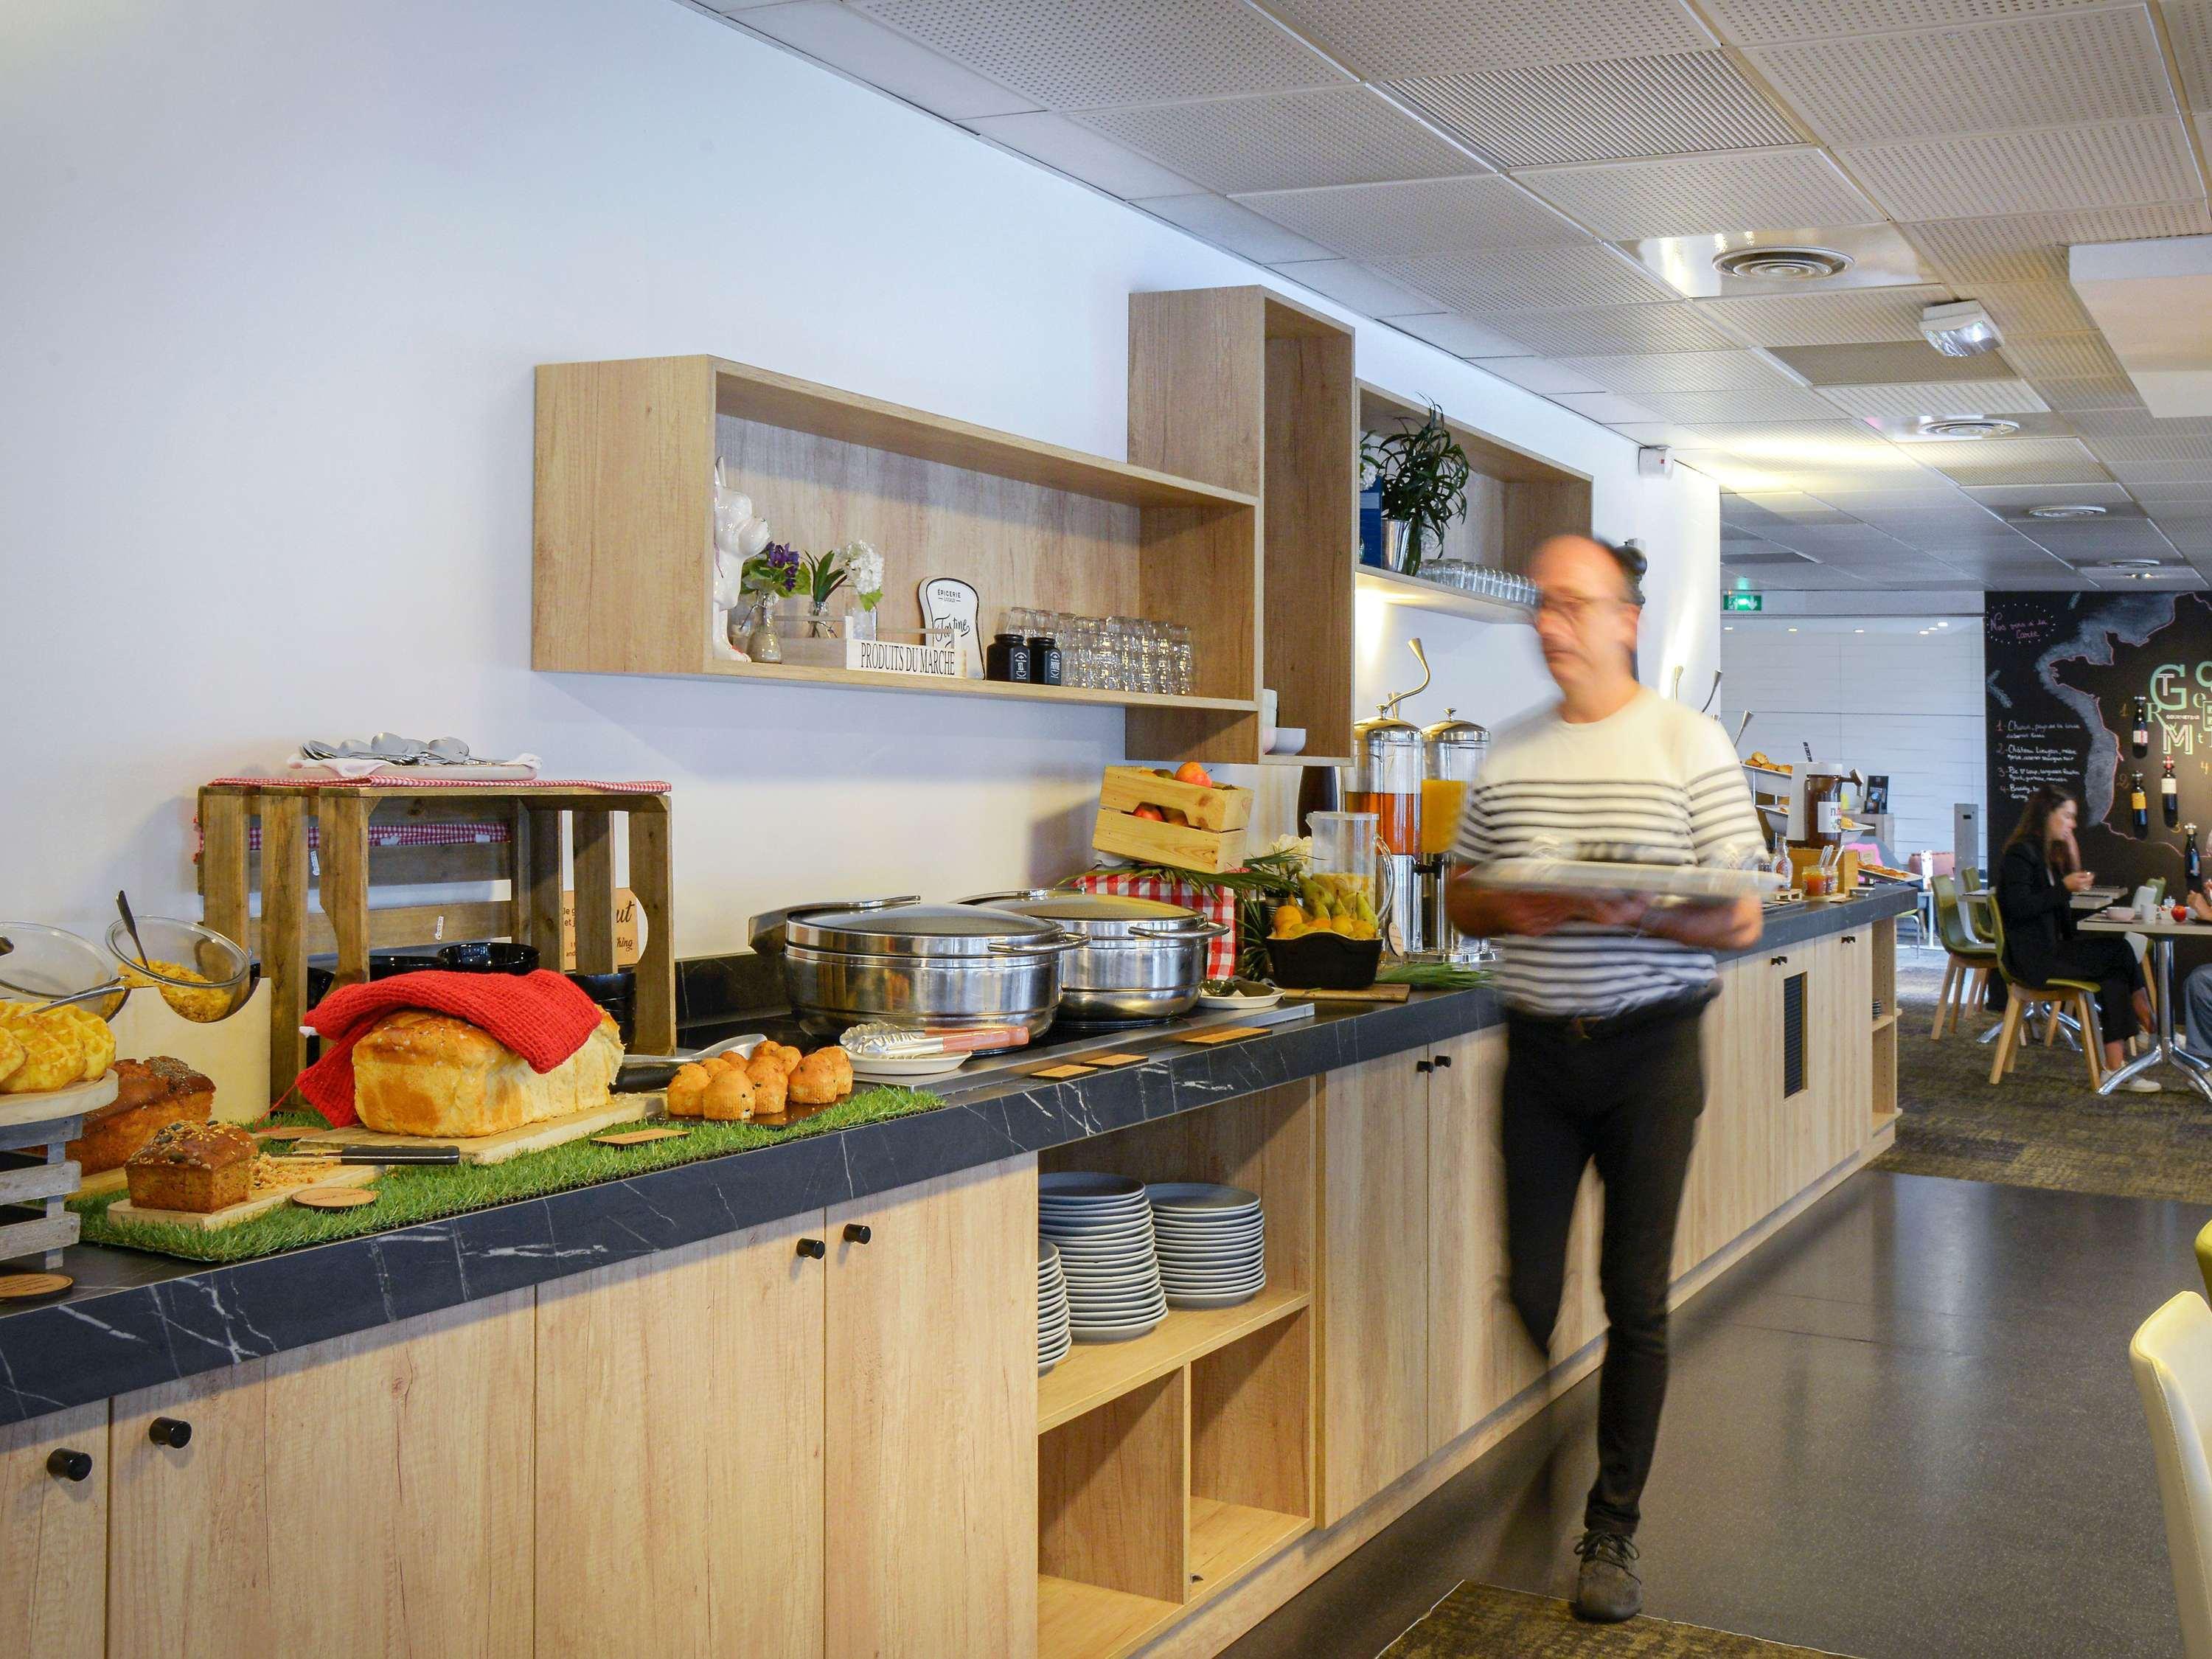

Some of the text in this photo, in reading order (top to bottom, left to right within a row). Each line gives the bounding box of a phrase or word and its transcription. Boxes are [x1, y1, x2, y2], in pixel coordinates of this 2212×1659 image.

[937, 588, 961, 599] ÉPICERIE
[933, 613, 970, 642] Tartine
[860, 642, 956, 675] PRODUITS DU MARCHE
